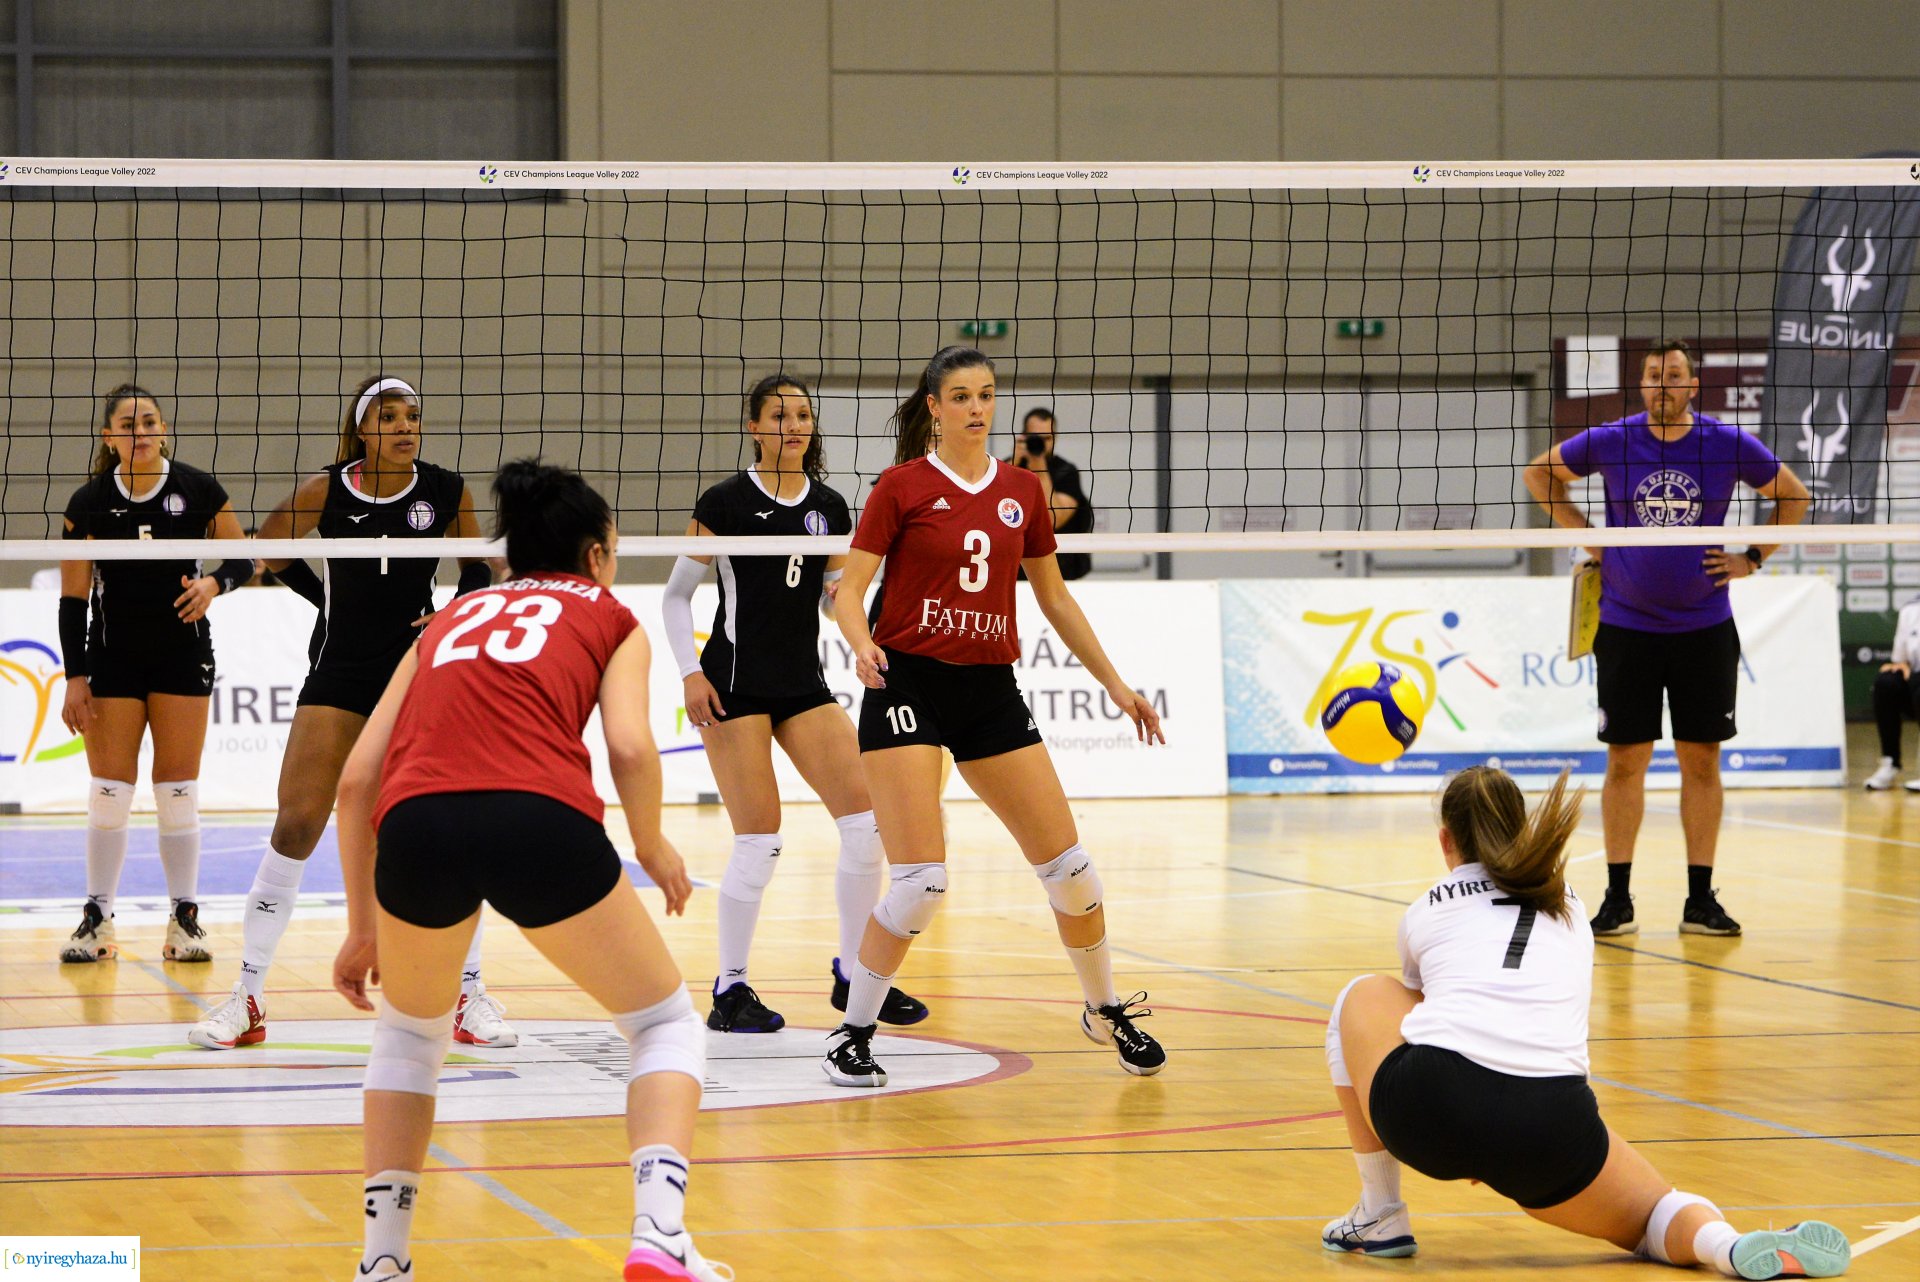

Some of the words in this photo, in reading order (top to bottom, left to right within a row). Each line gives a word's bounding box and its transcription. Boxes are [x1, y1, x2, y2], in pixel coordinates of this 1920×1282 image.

[15, 166, 32, 175] CEV
[34, 166, 79, 176] Champions
[80, 167, 110, 177] League
[111, 167, 136, 177] Volley
[137, 168, 156, 176] 2022
[503, 170, 520, 178] CEV
[521, 170, 565, 180] Champions
[566, 171, 595, 180] League
[596, 171, 620, 180] Volley
[621, 171, 640, 179] 2022
[976, 171, 992, 179] CEV
[993, 171, 1036, 180] Champions
[1037, 171, 1065, 180] League
[1066, 171, 1089, 180] Volley
[1090, 171, 1108, 179] 2022
[1436, 169, 1452, 177] CEV
[1453, 169, 1494, 179] Champions
[1495, 169, 1523, 179] League
[1524, 169, 1546, 179] Volley
[1547, 169, 1565, 177] 2022
[786, 553, 804, 588] 6
[959, 529, 991, 593] 3
[432, 593, 563, 669] 23
[918, 597, 1008, 635] FATUM
[886, 705, 918, 735] 10
[1048, 732, 1135, 753] Nonprofit
[1491, 896, 1538, 970] 7
